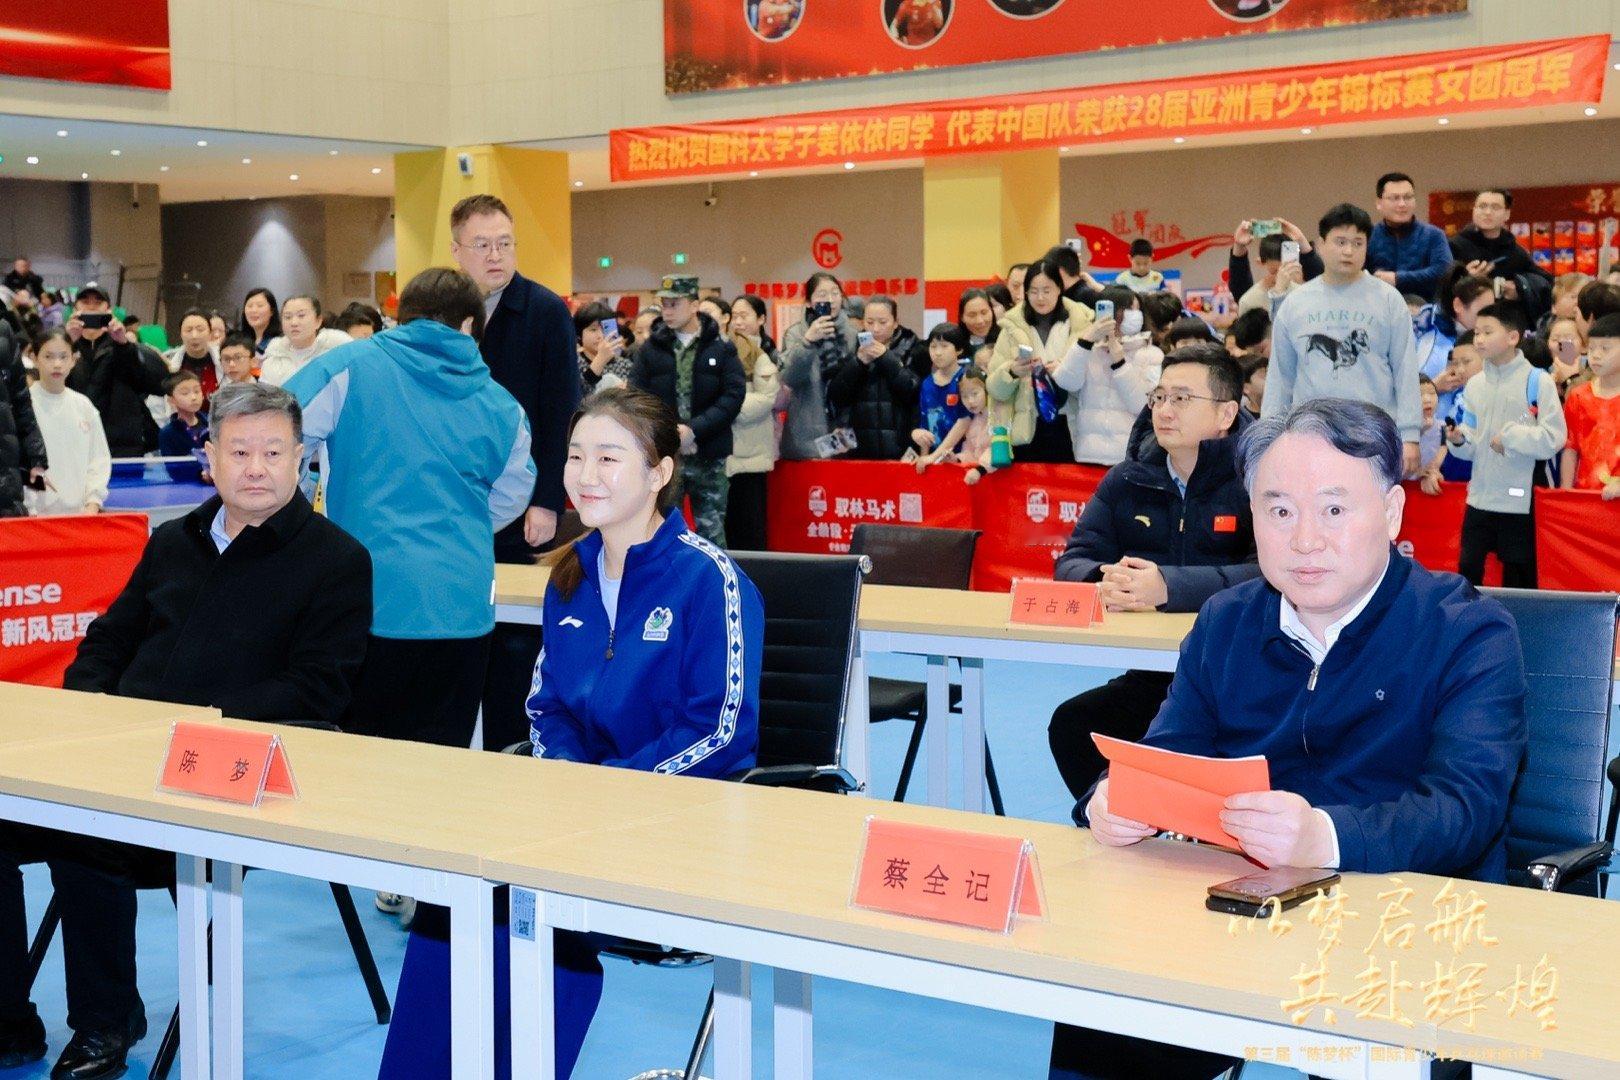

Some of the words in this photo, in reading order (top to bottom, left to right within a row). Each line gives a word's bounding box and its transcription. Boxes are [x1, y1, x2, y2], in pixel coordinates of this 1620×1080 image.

[947, 52, 1574, 147] 代表中国队荣获28届亚洲青少年锦标赛女团冠军
[1307, 309, 1374, 325] MARDI
[0, 582, 62, 607] nse
[1023, 597, 1080, 615] 于占海
[178, 750, 250, 783] 陈梦
[882, 857, 990, 903] 蔡全记
